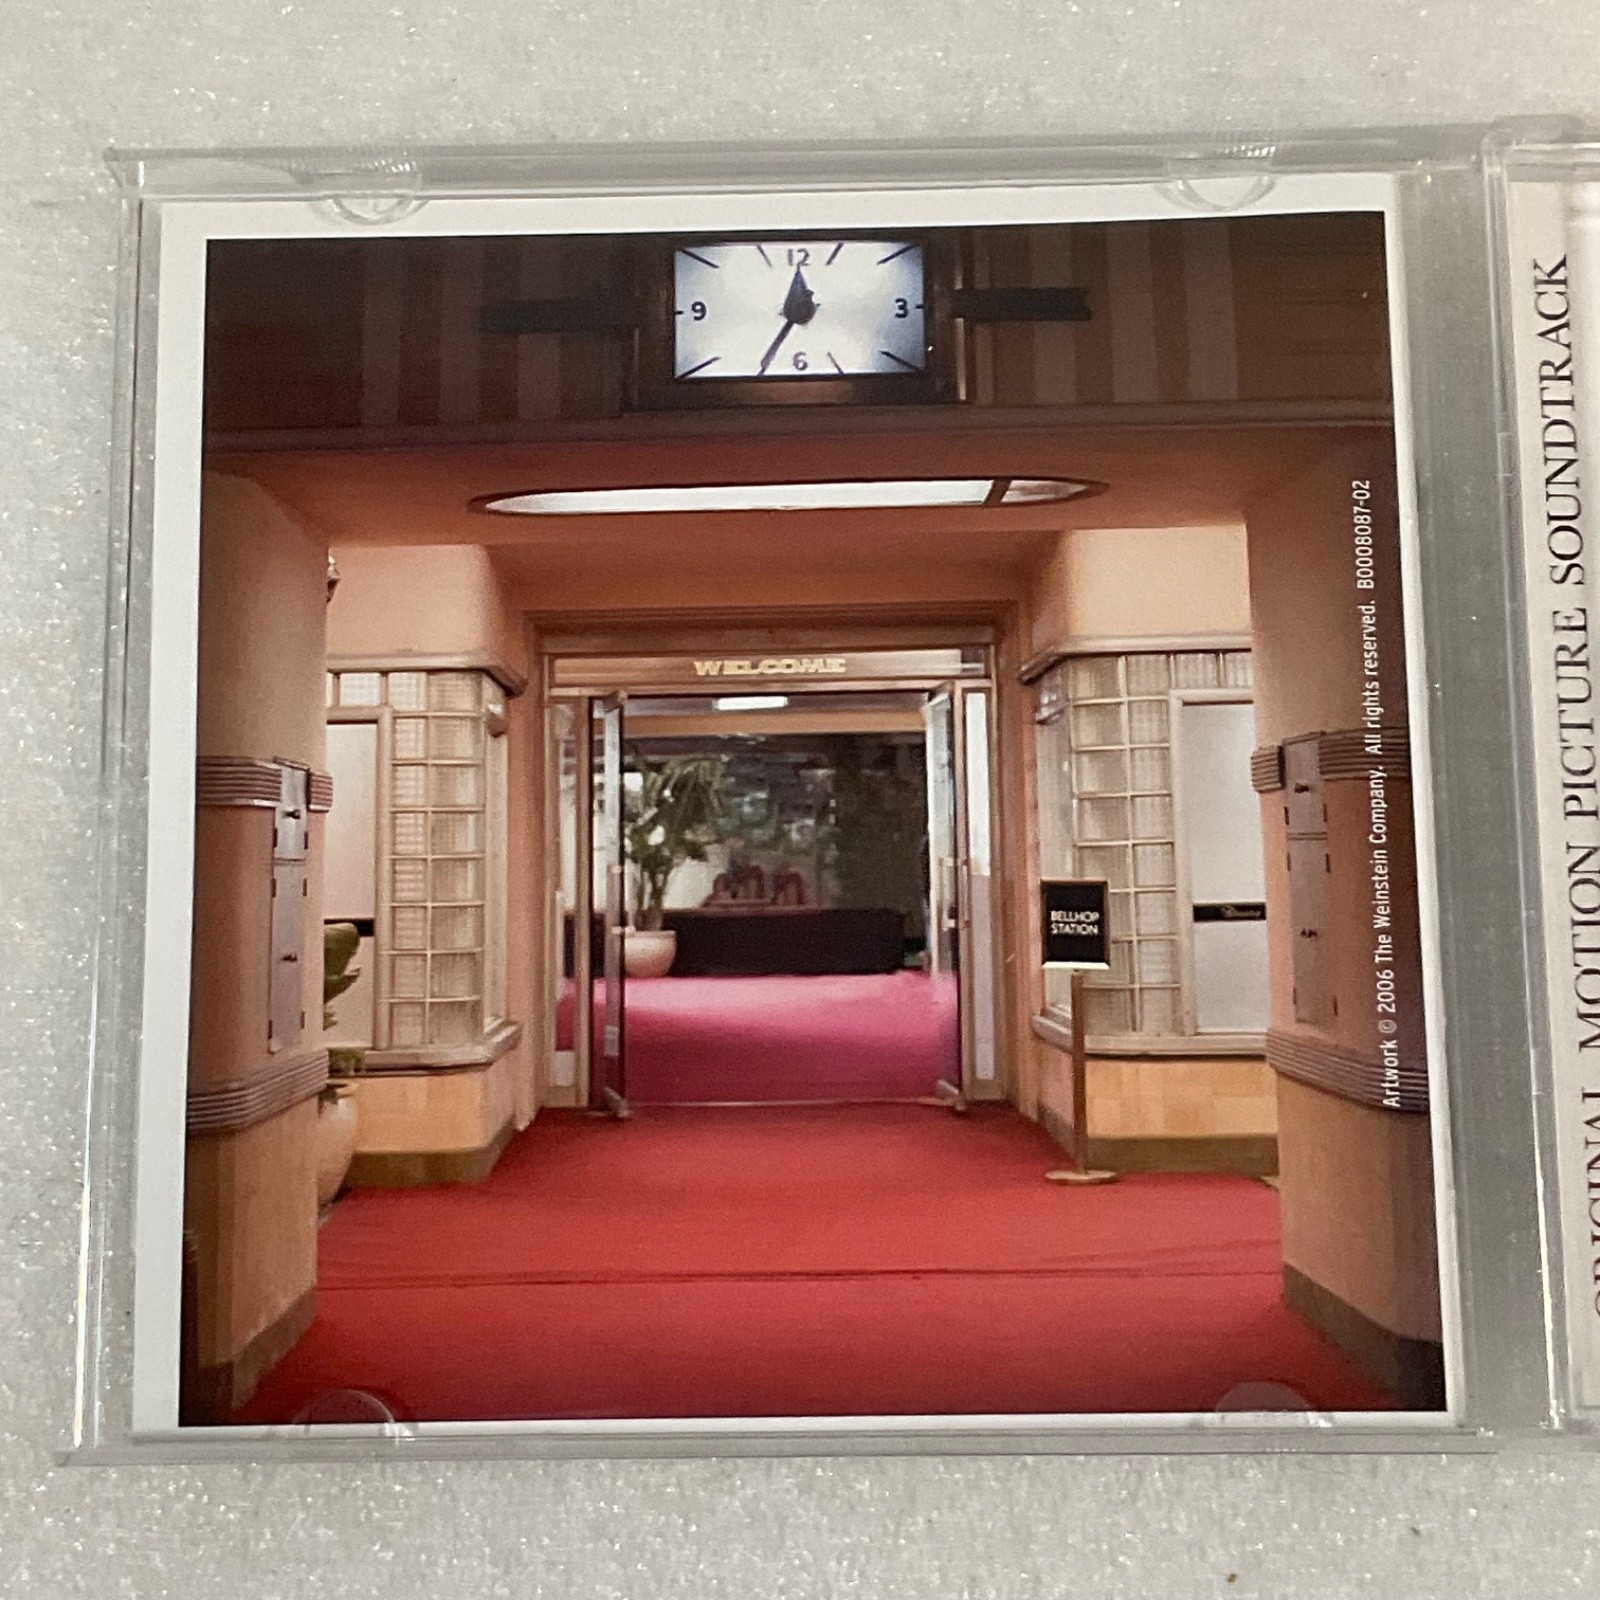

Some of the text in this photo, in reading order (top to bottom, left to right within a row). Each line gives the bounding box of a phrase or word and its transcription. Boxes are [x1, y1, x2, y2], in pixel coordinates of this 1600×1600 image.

[787, 248, 810, 267] 12
[691, 301, 707, 321] 9
[894, 298, 909, 318] 3
[792, 352, 808, 371] 6
[1533, 253, 1586, 585] SOUNDTRACK
[1352, 479, 1375, 590] B0008087-02
[1357, 600, 1380, 677] reserved.
[693, 657, 847, 676] WELCOME
[1361, 681, 1384, 727] rights
[1552, 607, 1599, 821] PICTURE
[1364, 734, 1383, 756] All
[1368, 765, 1388, 844] Company.
[1369, 849, 1391, 929] Weinstein
[1050, 910, 1100, 923] BELLHOP
[1051, 923, 1099, 936] STATION
[1374, 934, 1393, 964] The
[1566, 841, 1600, 1052] MOTION
[1376, 969, 1396, 1013] 2006
[1382, 1038, 1400, 1109] Artwork
